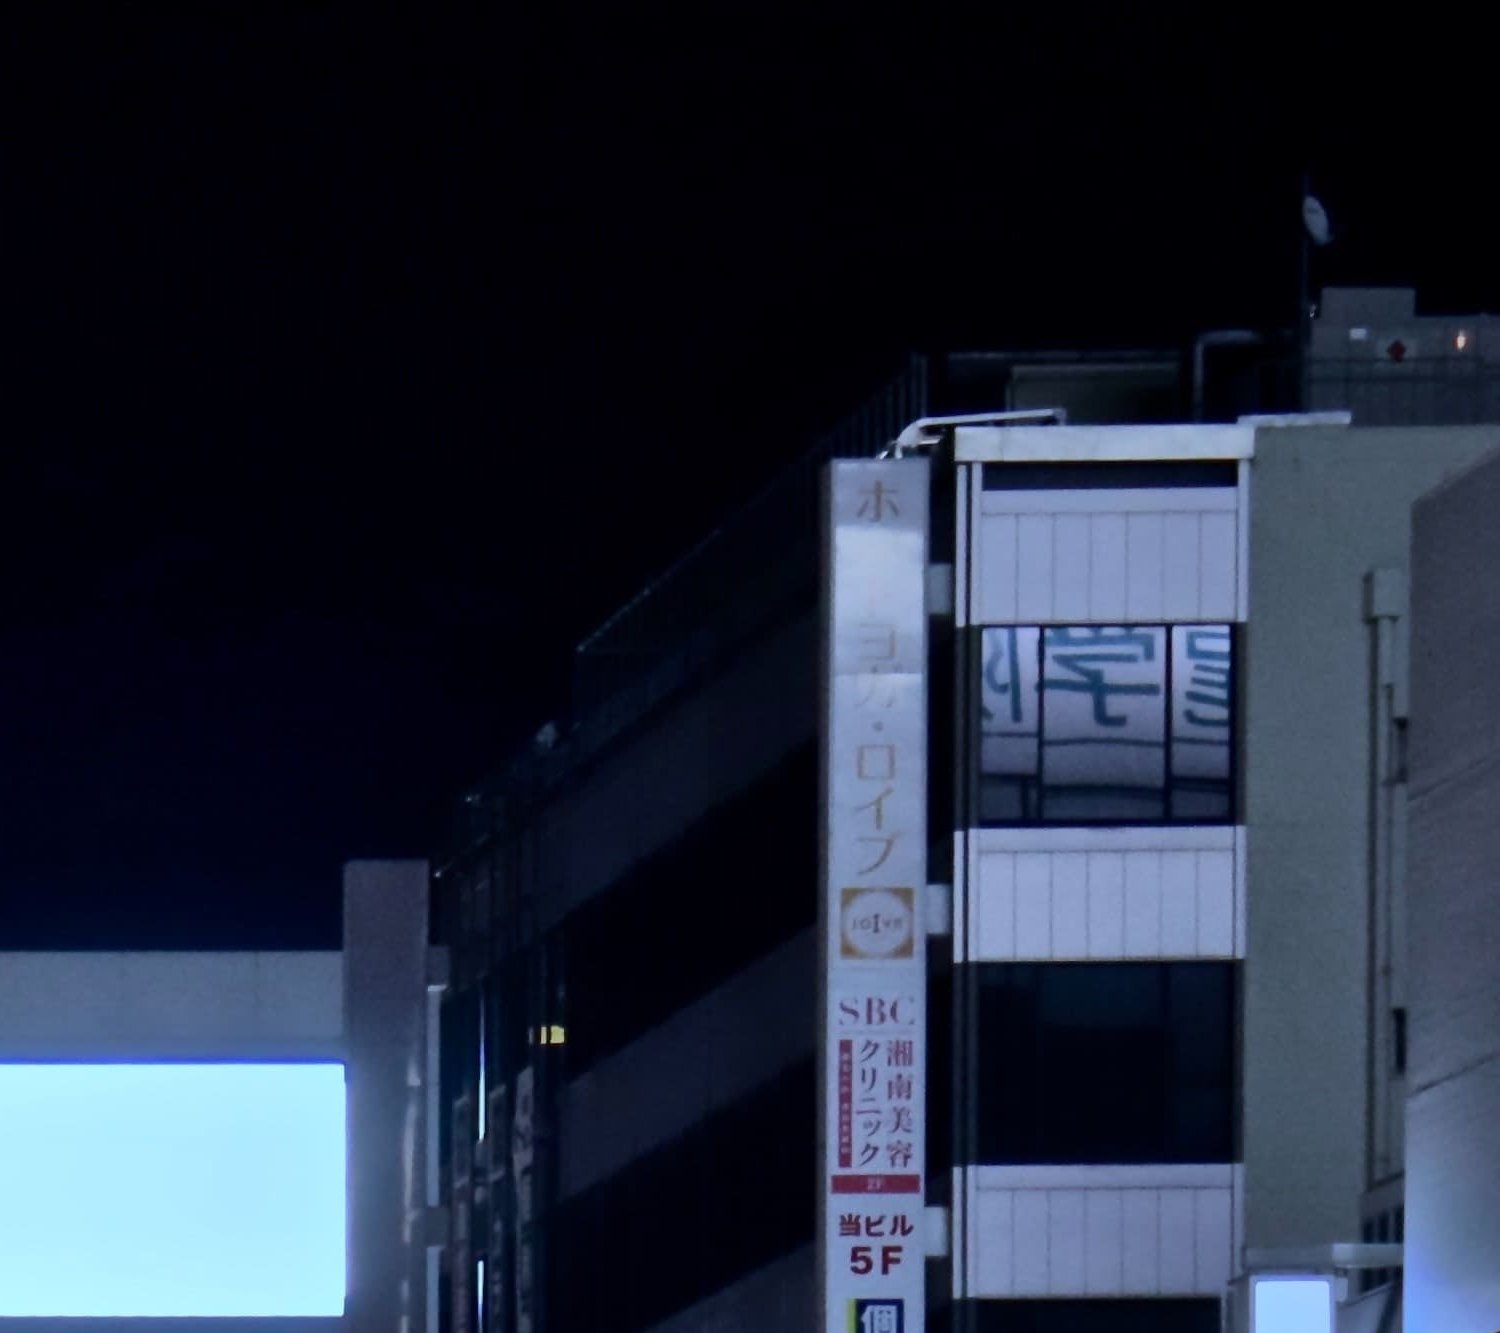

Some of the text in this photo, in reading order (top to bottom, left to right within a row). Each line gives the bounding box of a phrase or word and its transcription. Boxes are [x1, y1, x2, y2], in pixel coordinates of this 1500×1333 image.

[838, 996, 915, 1026] SBC
[855, 1039, 881, 1167] クリニック
[886, 1039, 913, 1168] 湘南美容
[839, 1213, 913, 1237] 当ビル
[849, 1245, 903, 1275] 5F
